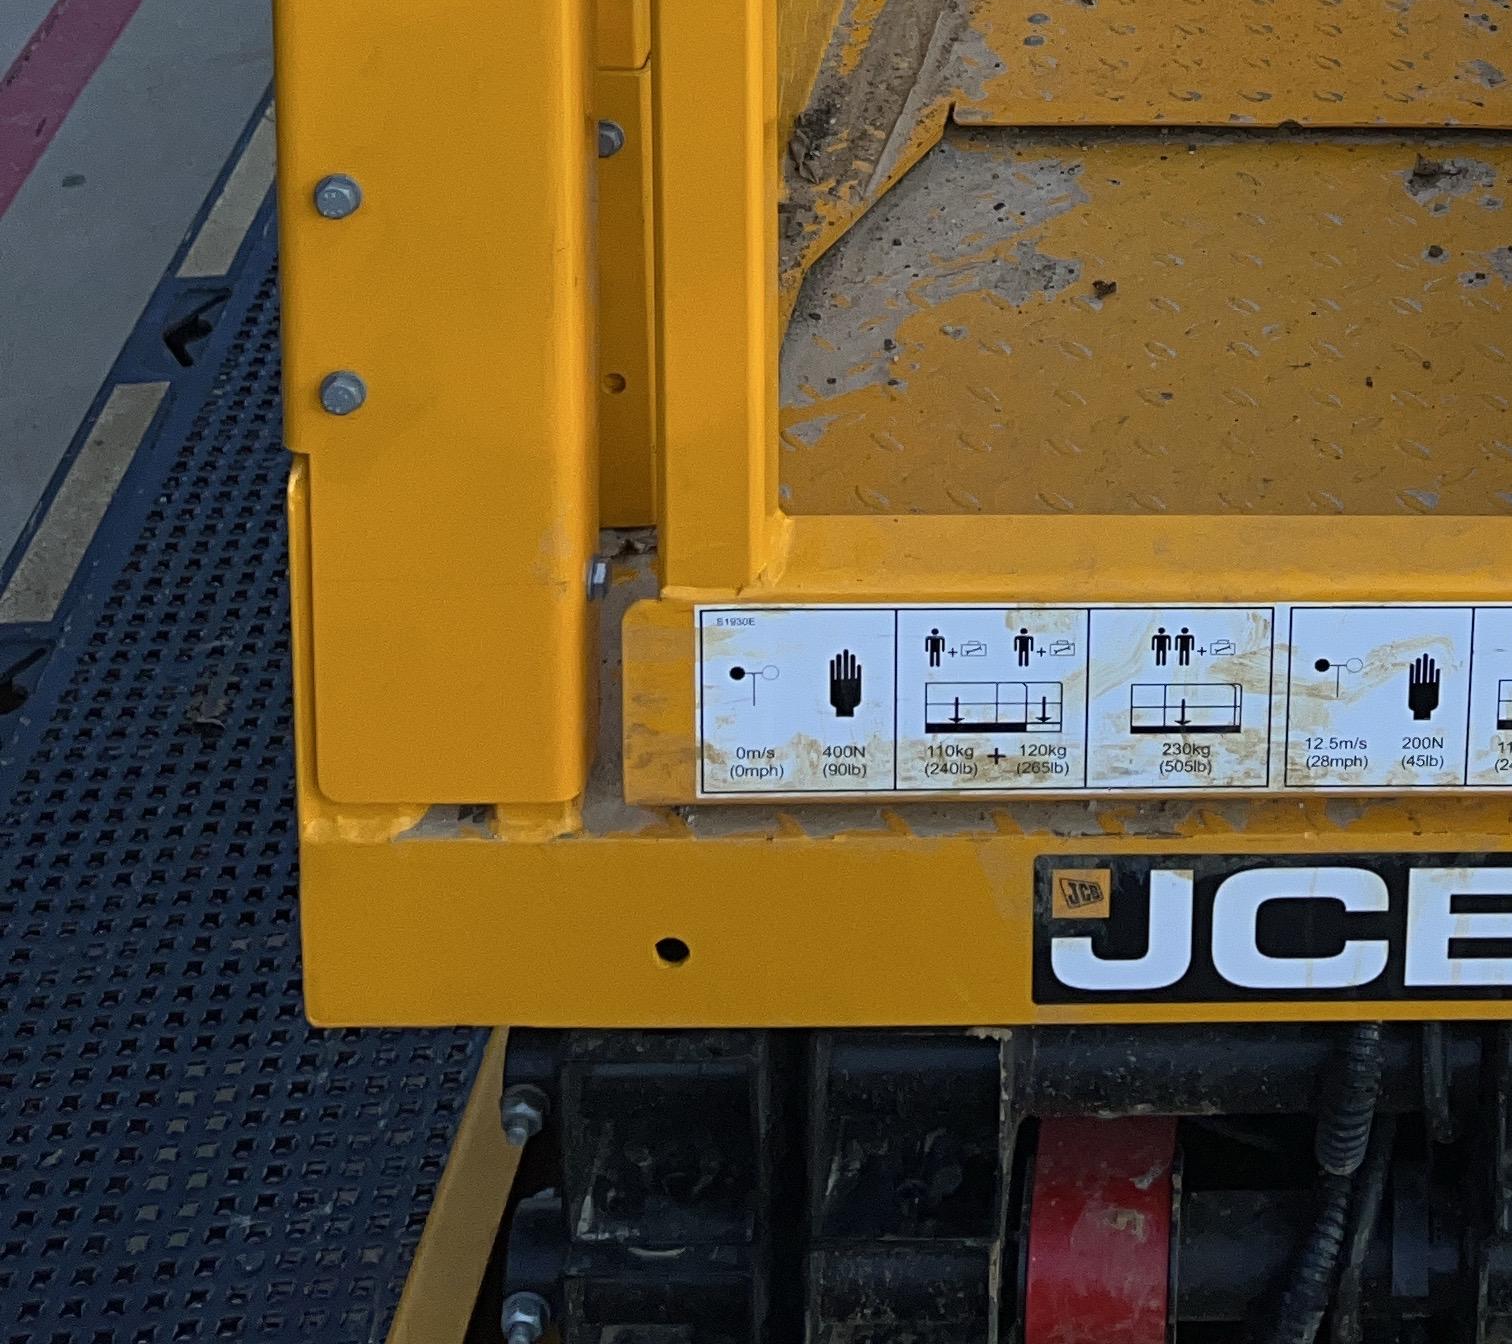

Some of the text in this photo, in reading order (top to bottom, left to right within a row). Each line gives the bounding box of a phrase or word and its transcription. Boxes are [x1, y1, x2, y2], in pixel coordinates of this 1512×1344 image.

[716, 616, 756, 627] S1930E
[1161, 742, 1212, 758] 230kg
[1305, 737, 1369, 750] 12.5m/s
[1401, 736, 1445, 750] 200N
[735, 746, 776, 760] 0m/s
[822, 744, 867, 759] 400N
[925, 744, 975, 760] 110kg
[1019, 744, 1068, 760] 120kg
[923, 761, 979, 778] (240lb)
[1015, 761, 1070, 778] (265lb)
[1158, 760, 1213, 776] (505lb)
[1305, 754, 1369, 770] (28mph)
[1400, 754, 1445, 769] (45lb)
[730, 763, 785, 780] (0mph)
[822, 762, 868, 779] (90lb)
[1067, 880, 1101, 905] JCB
